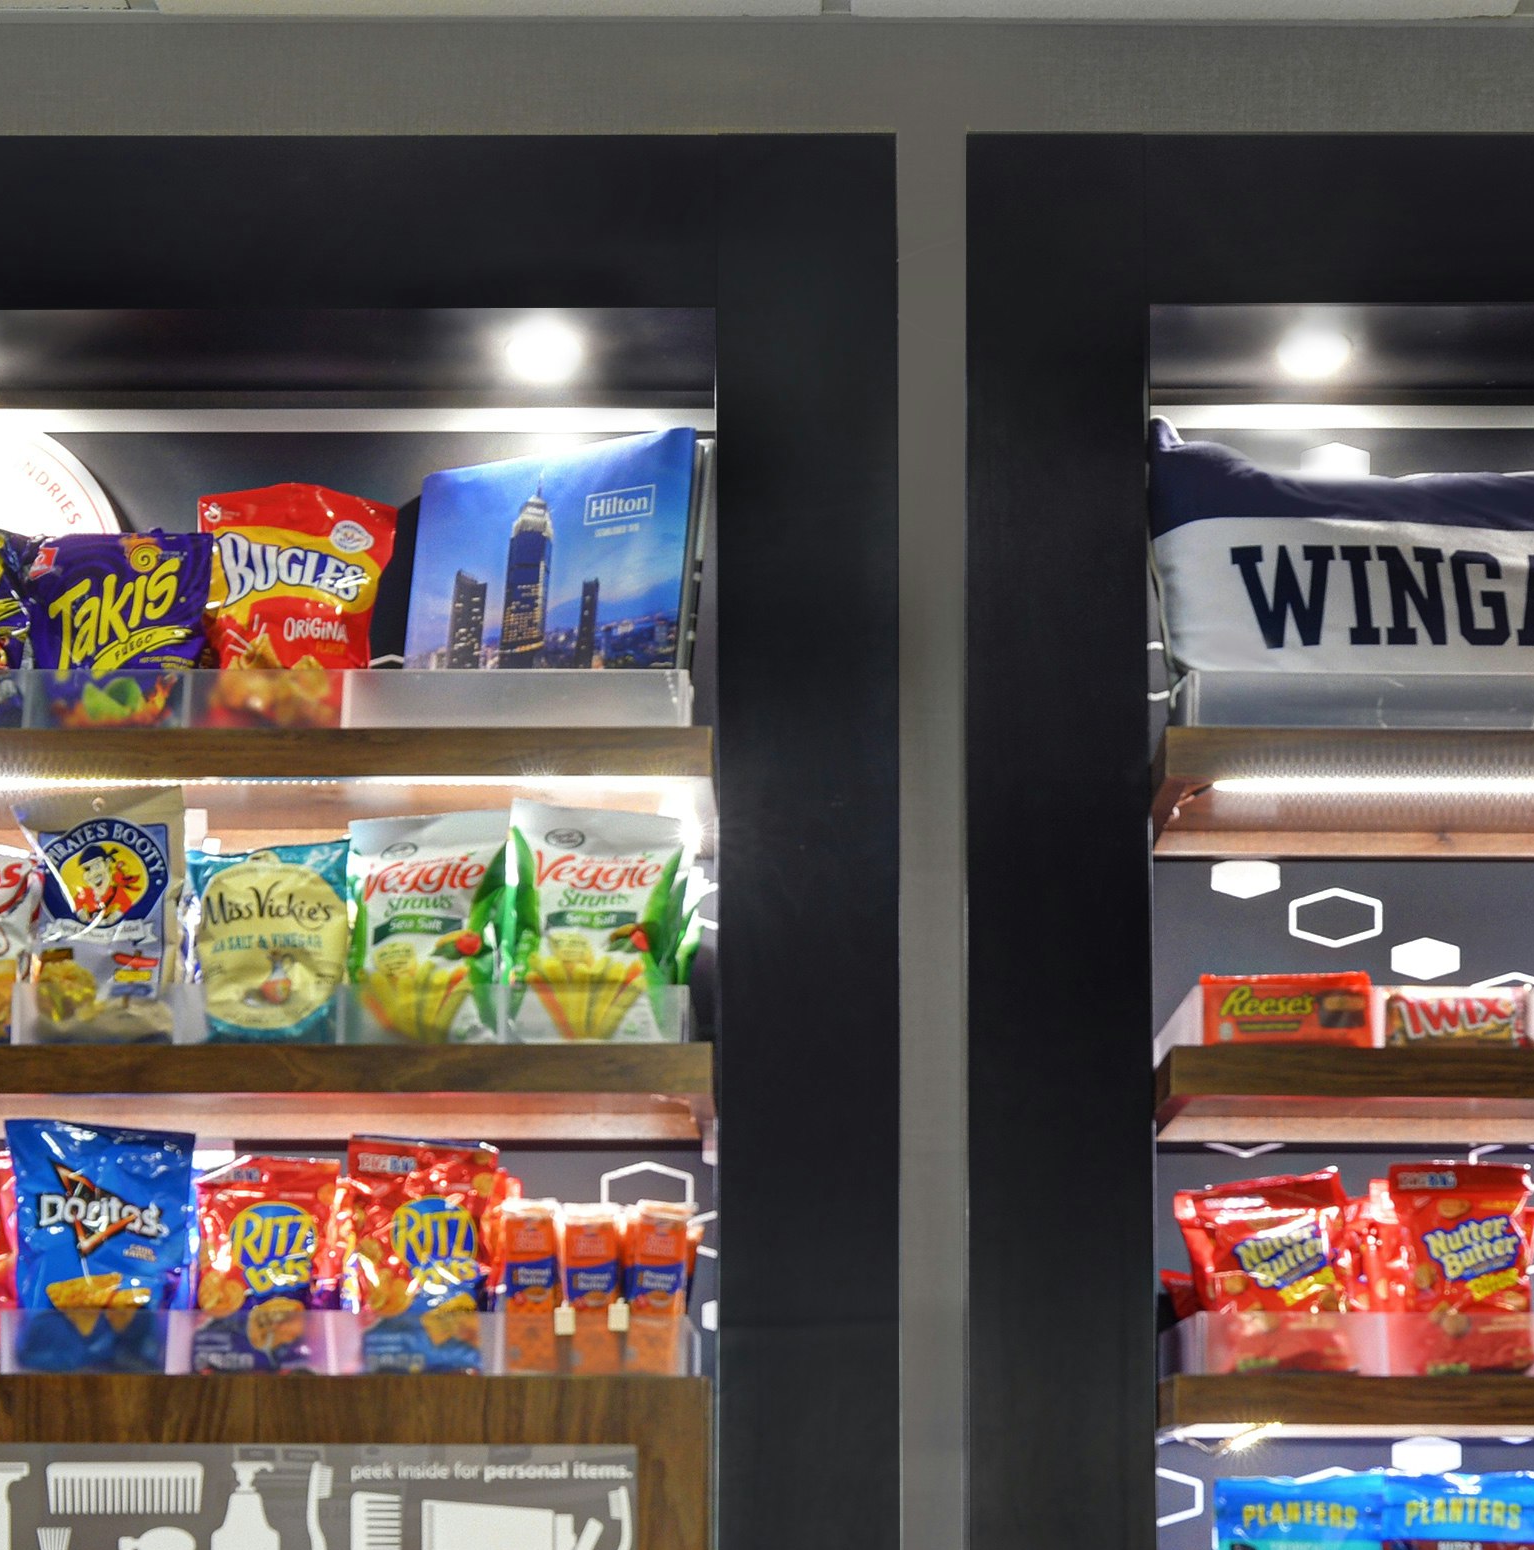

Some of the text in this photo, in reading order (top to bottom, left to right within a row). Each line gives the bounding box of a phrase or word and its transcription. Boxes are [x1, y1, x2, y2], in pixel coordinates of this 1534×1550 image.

[590, 492, 649, 518] Hilton
[218, 532, 364, 608] BUGLES
[112, 822, 166, 873] BOOTY
[363, 855, 486, 902] Veggie
[534, 850, 662, 892] Veggie
[204, 881, 335, 931] Miss Vickie's
[1220, 986, 1316, 1016] Reese's
[1396, 998, 1510, 1039] TWIX
[39, 1193, 163, 1237] Doritos
[396, 1206, 473, 1263] RITZ
[233, 1211, 311, 1264] RITZ
[1424, 1217, 1508, 1259] Nutter
[1441, 1235, 1520, 1281] Butter
[350, 1461, 634, 1483] peek inside for personal items.
[1242, 1501, 1358, 1530] PLANTERS
[1405, 1497, 1523, 1530] PLANTERS
